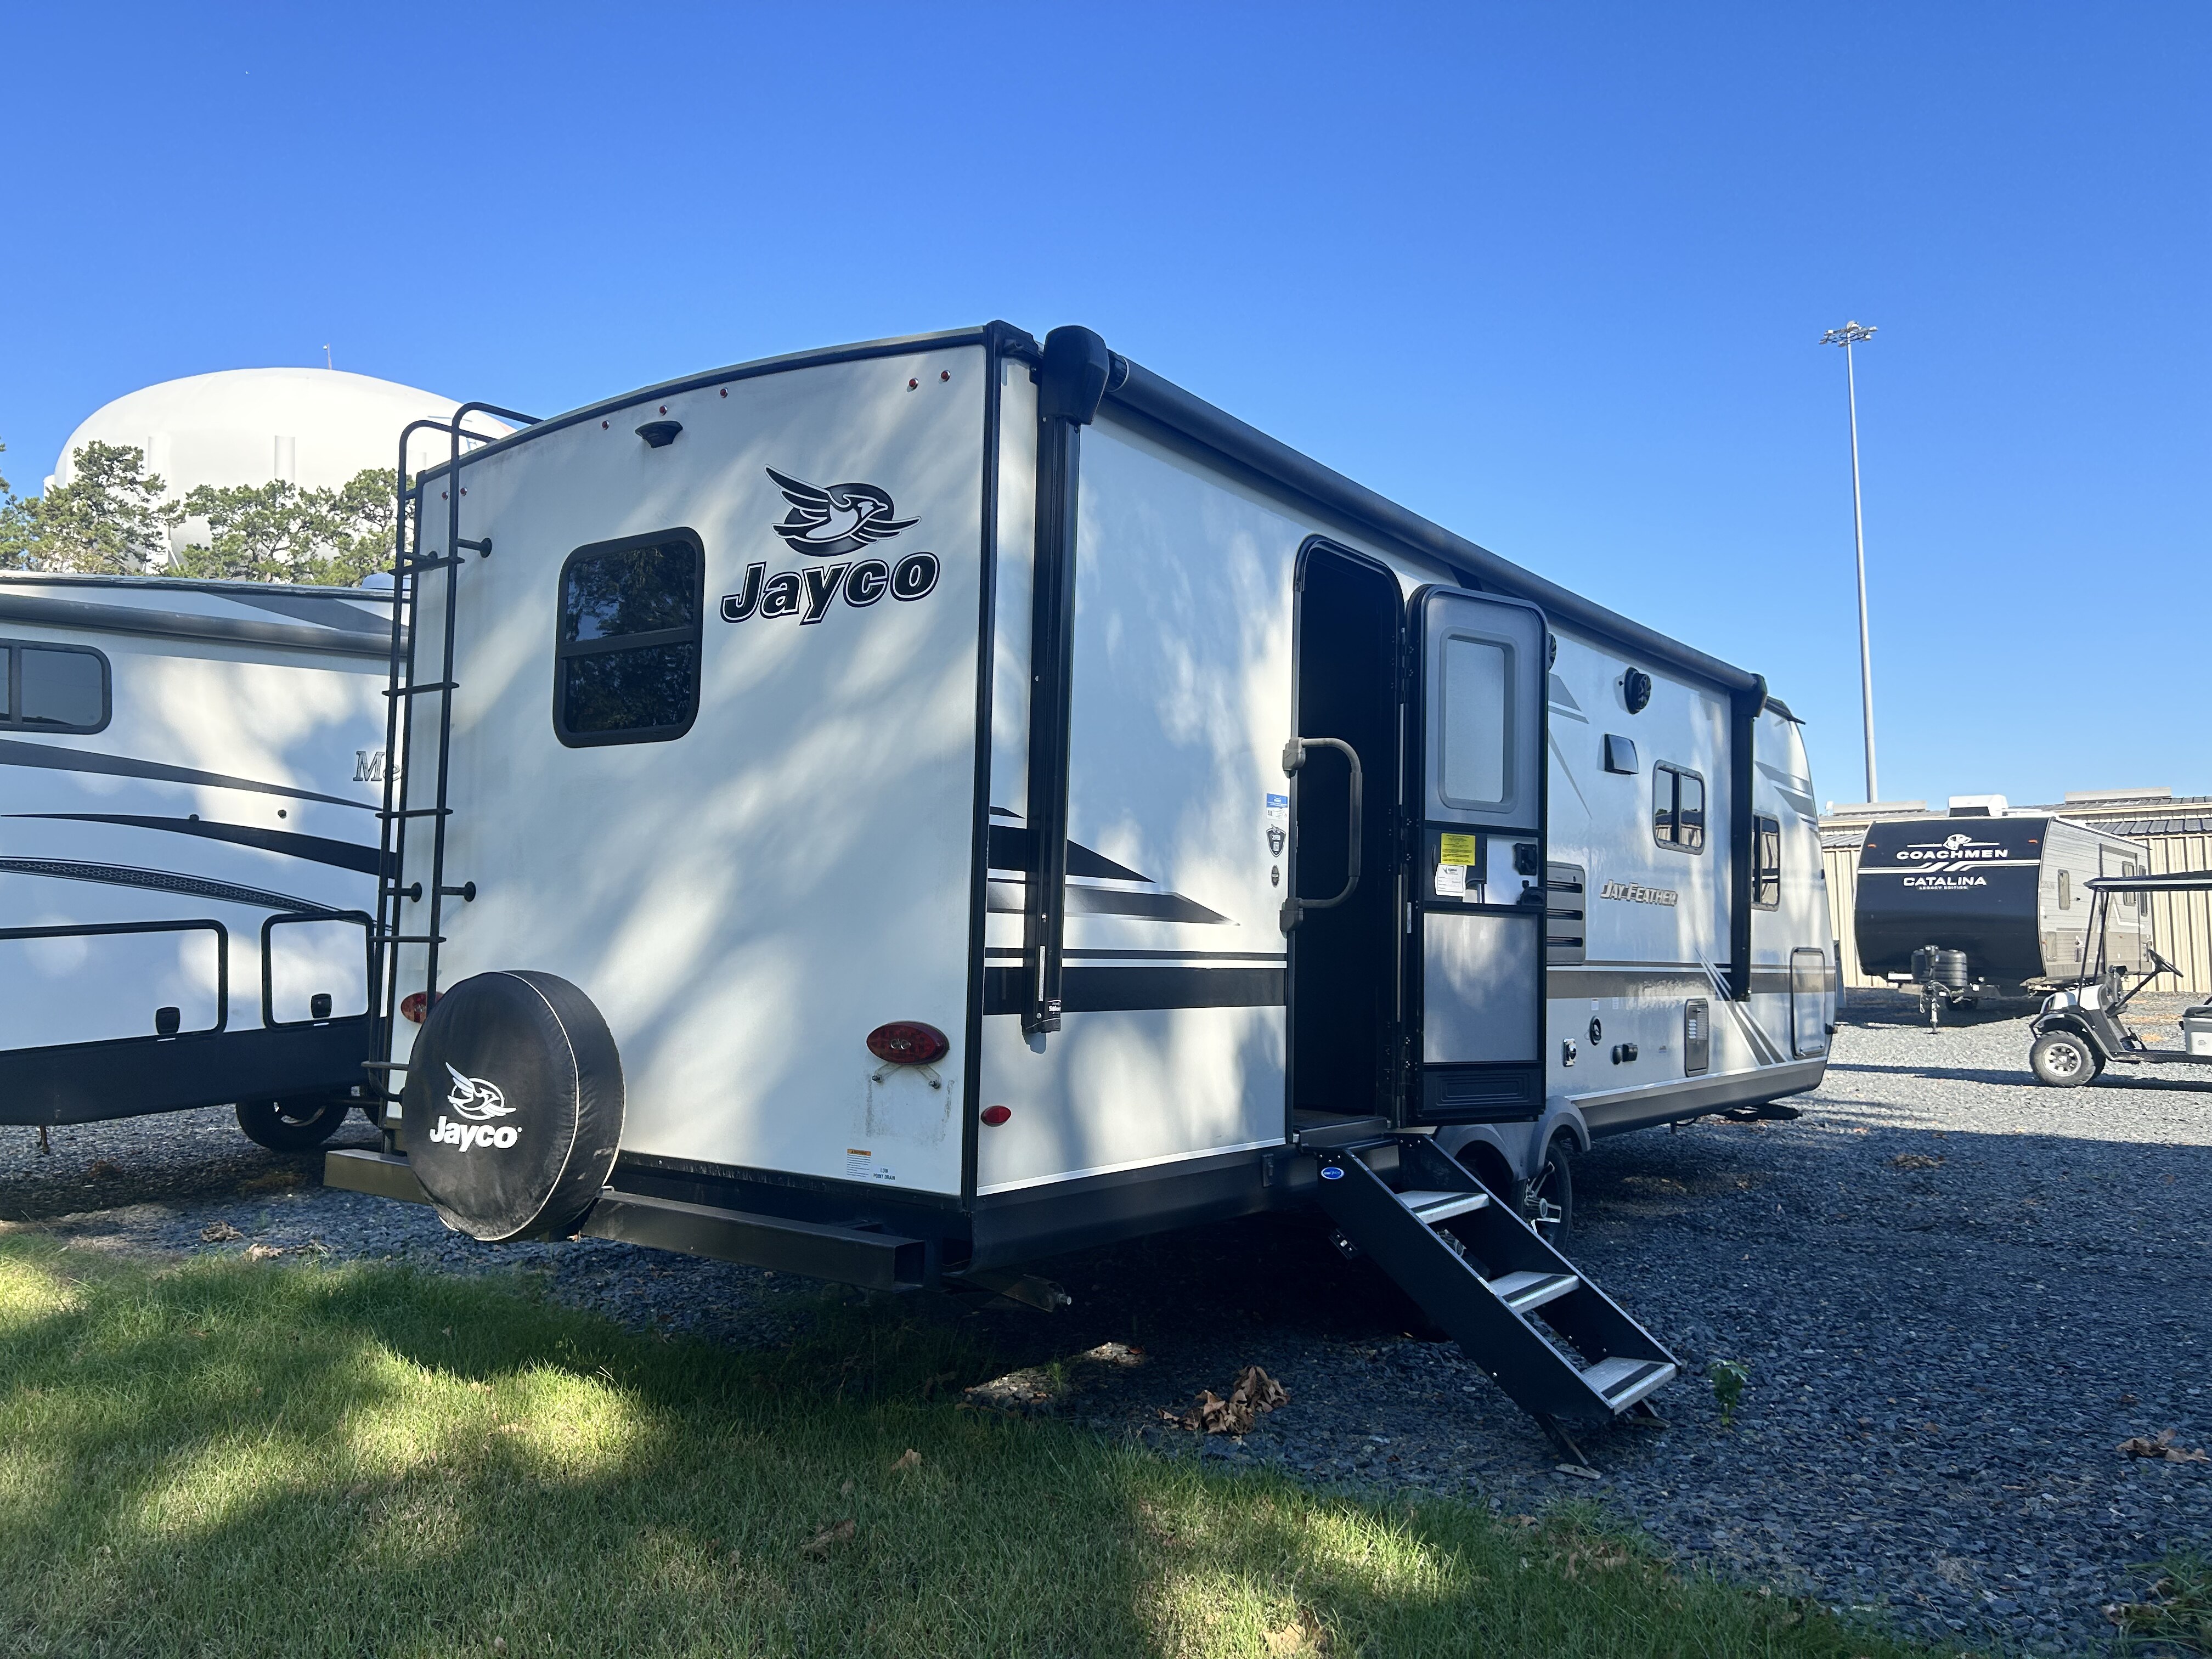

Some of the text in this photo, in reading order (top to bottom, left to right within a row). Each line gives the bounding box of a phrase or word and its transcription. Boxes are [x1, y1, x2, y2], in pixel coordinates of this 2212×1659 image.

[720, 551, 940, 626] Jayco
[1896, 849, 2008, 860] COACHMEN
[1600, 879, 1678, 907] JAY FEATHER
[1903, 876, 1987, 887] CATALINA
[430, 1115, 518, 1153] Jayco
